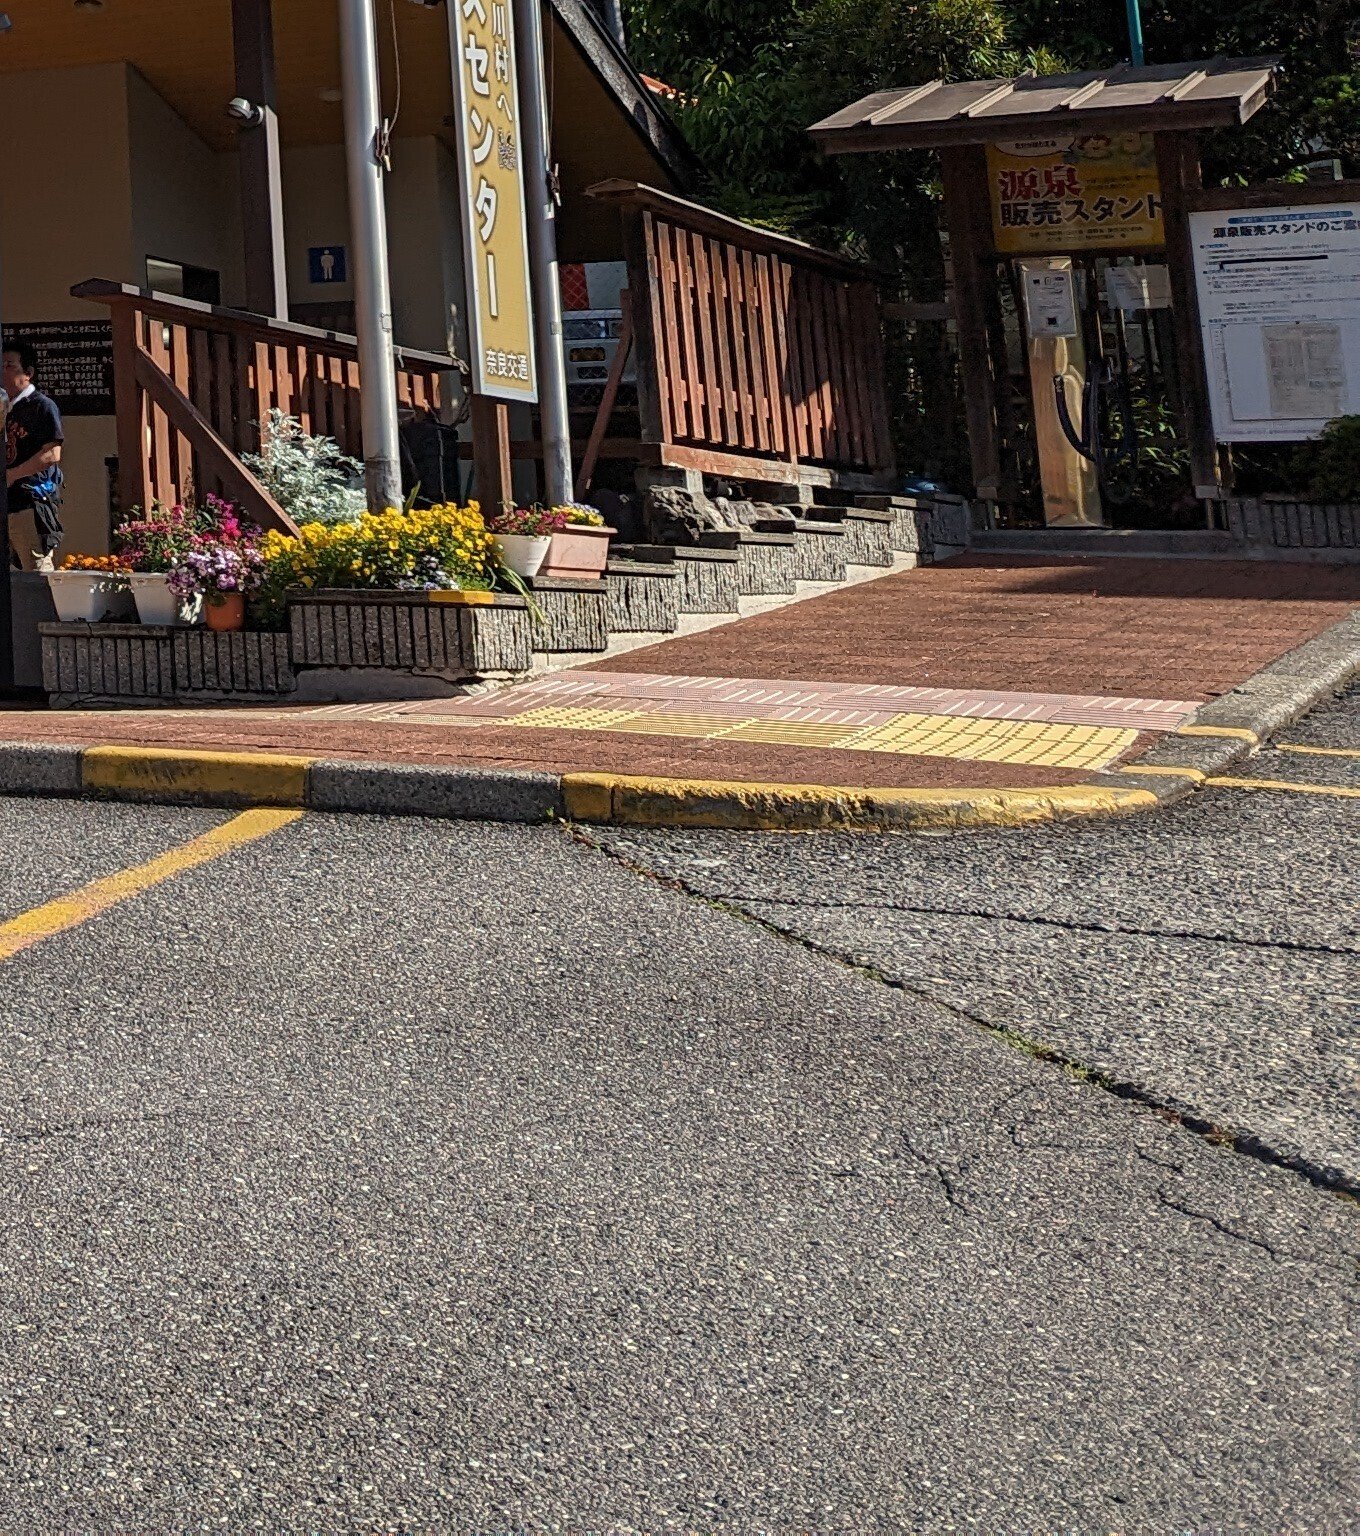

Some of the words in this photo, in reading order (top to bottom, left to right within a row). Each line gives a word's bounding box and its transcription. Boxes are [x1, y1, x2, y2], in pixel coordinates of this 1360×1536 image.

[998, 164, 1082, 200] 源泉
[485, 349, 529, 381] 奈良交通
